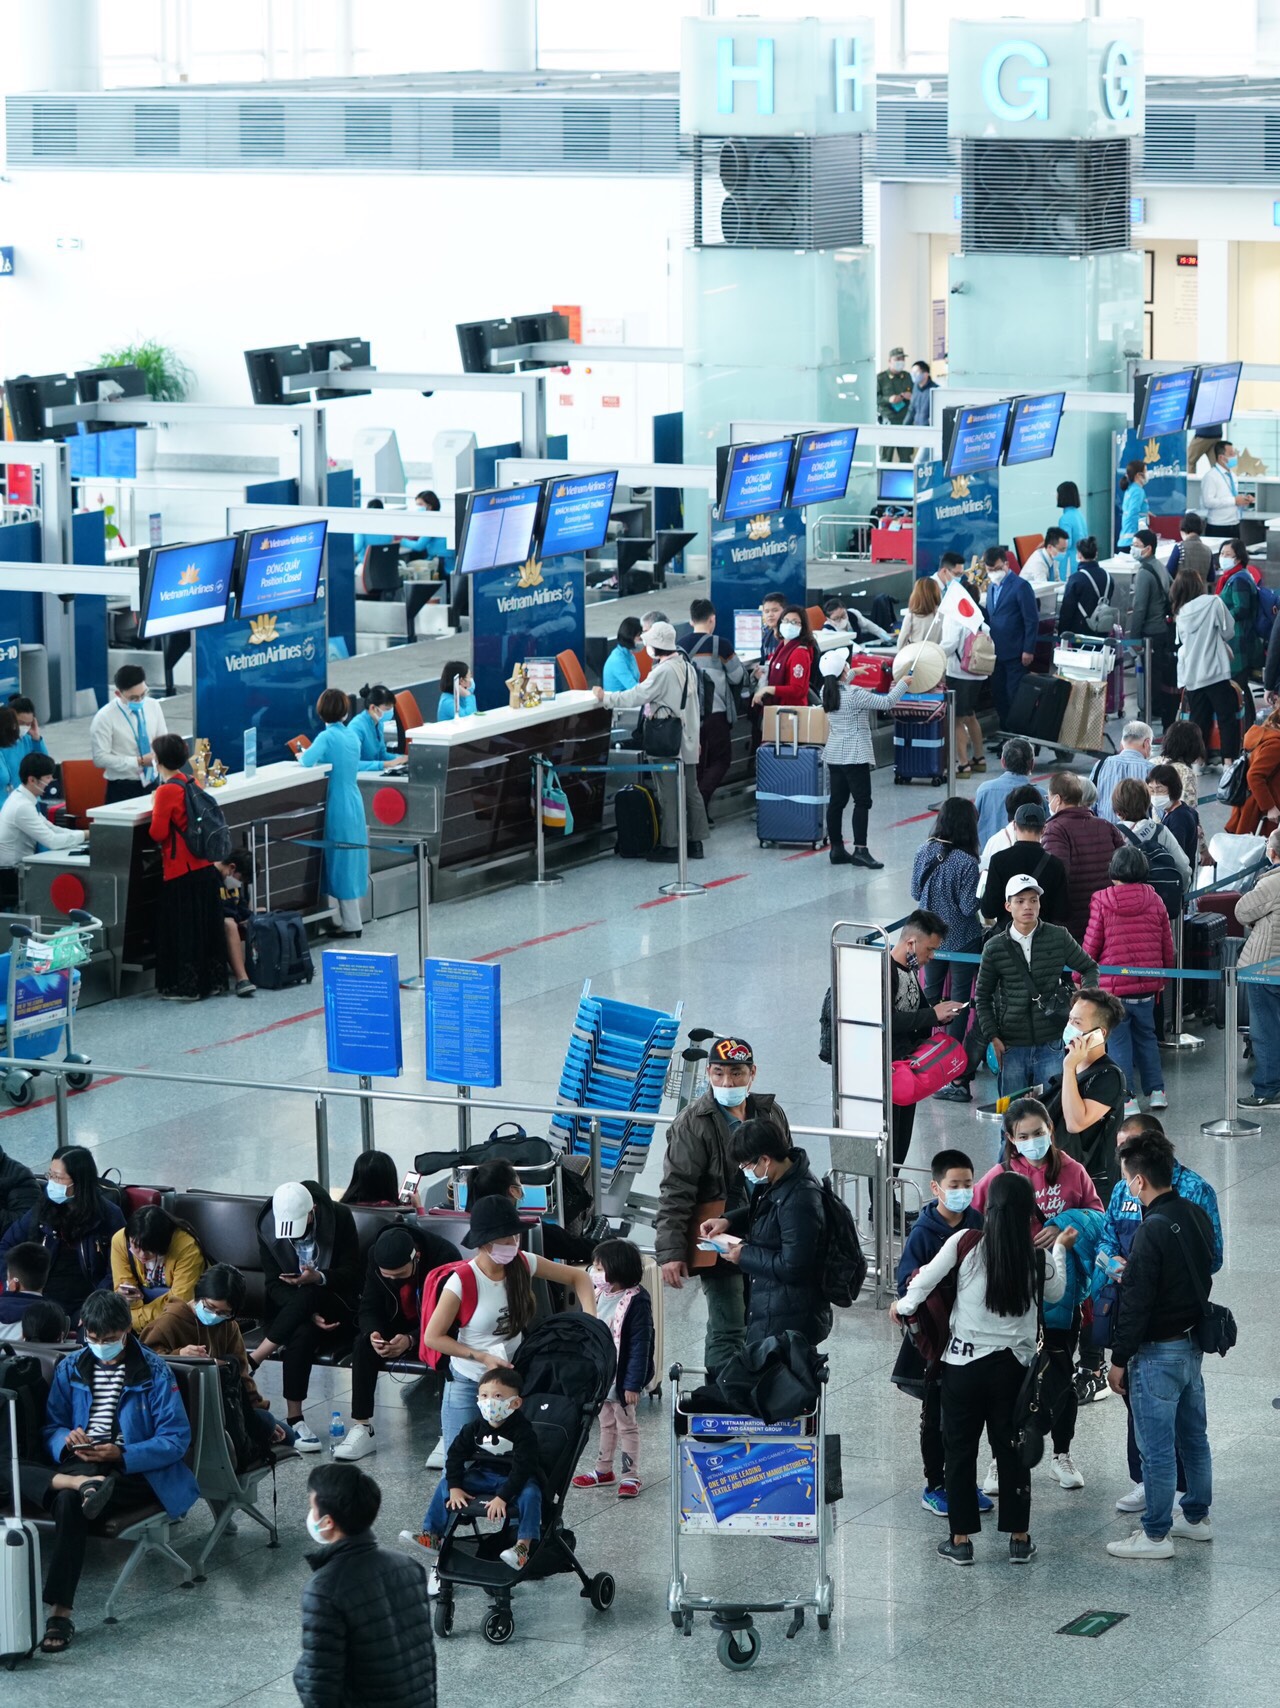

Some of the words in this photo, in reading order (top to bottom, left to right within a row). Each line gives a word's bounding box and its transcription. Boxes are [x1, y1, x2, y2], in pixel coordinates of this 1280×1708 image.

[717, 38, 774, 115] H
[835, 38, 862, 113] H
[982, 39, 1050, 121] G
[1104, 39, 1135, 120] G
[260, 575, 283, 588] Position
[283, 571, 302, 583] Closed
[708, 1479, 720, 1489] ONE
[719, 1476, 727, 1485] OF
[727, 1472, 739, 1483] THE
[739, 1465, 762, 1479] LEADING
[710, 1484, 733, 1497] TEXTILE
[732, 1480, 743, 1490] AND
[743, 1473, 767, 1487] GARMENT
[766, 1457, 809, 1479] MANUFACTURERS
